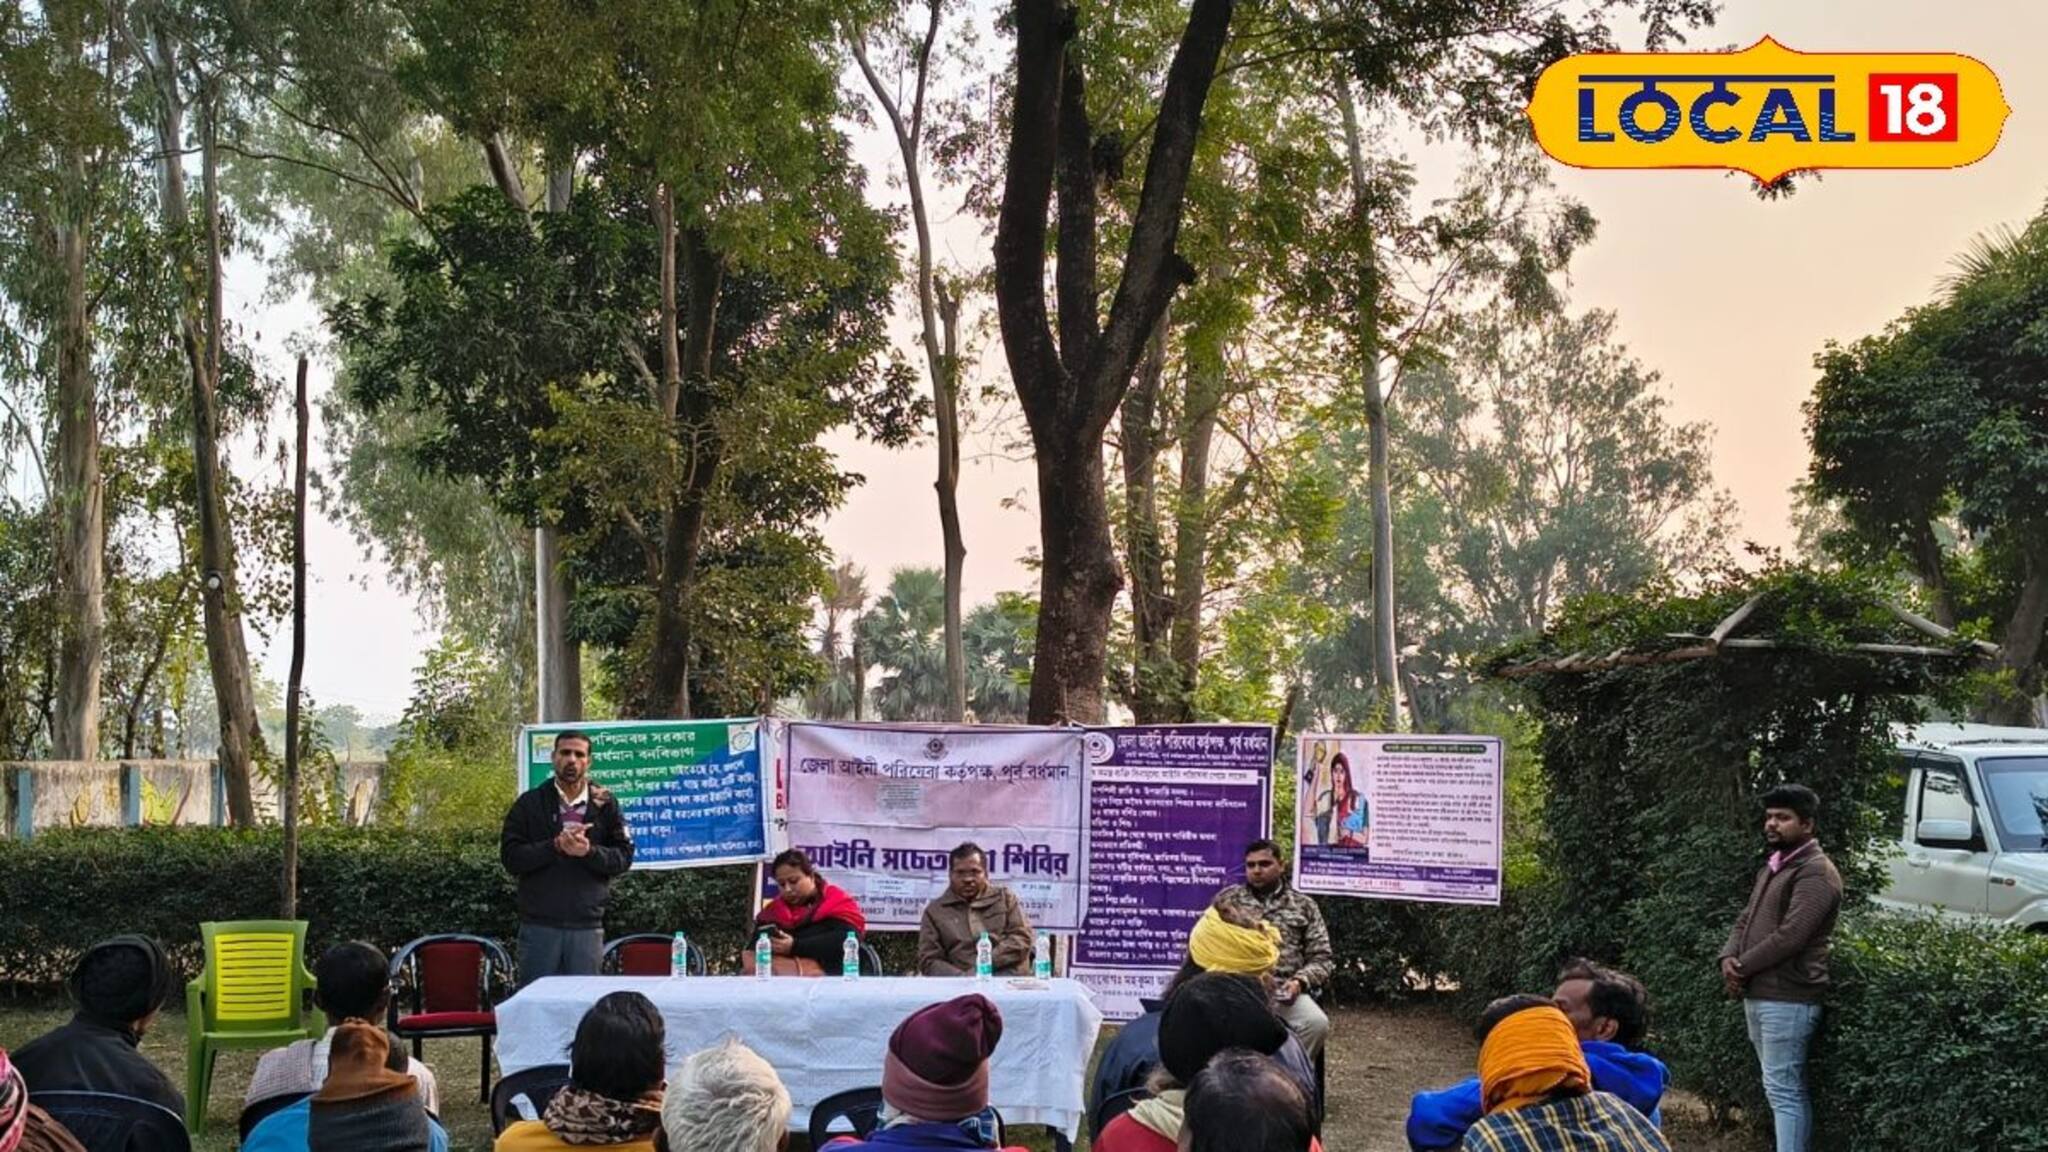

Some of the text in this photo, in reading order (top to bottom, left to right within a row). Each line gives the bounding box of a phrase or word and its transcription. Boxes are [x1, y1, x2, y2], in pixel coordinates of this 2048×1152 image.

[652, 731, 695, 743] সরকার
[1117, 734, 1137, 749] জেলা
[592, 746, 694, 762] বর্ধমান বনবিভাগ
[800, 755, 1070, 785] জেলা আইনী পরিষেবা কর্তৃপক্ষ, পূর্ব বর্ধমান
[796, 838, 877, 870] আইনি
[881, 847, 997, 873] সচেতা
[1002, 843, 1070, 877] শিবির
